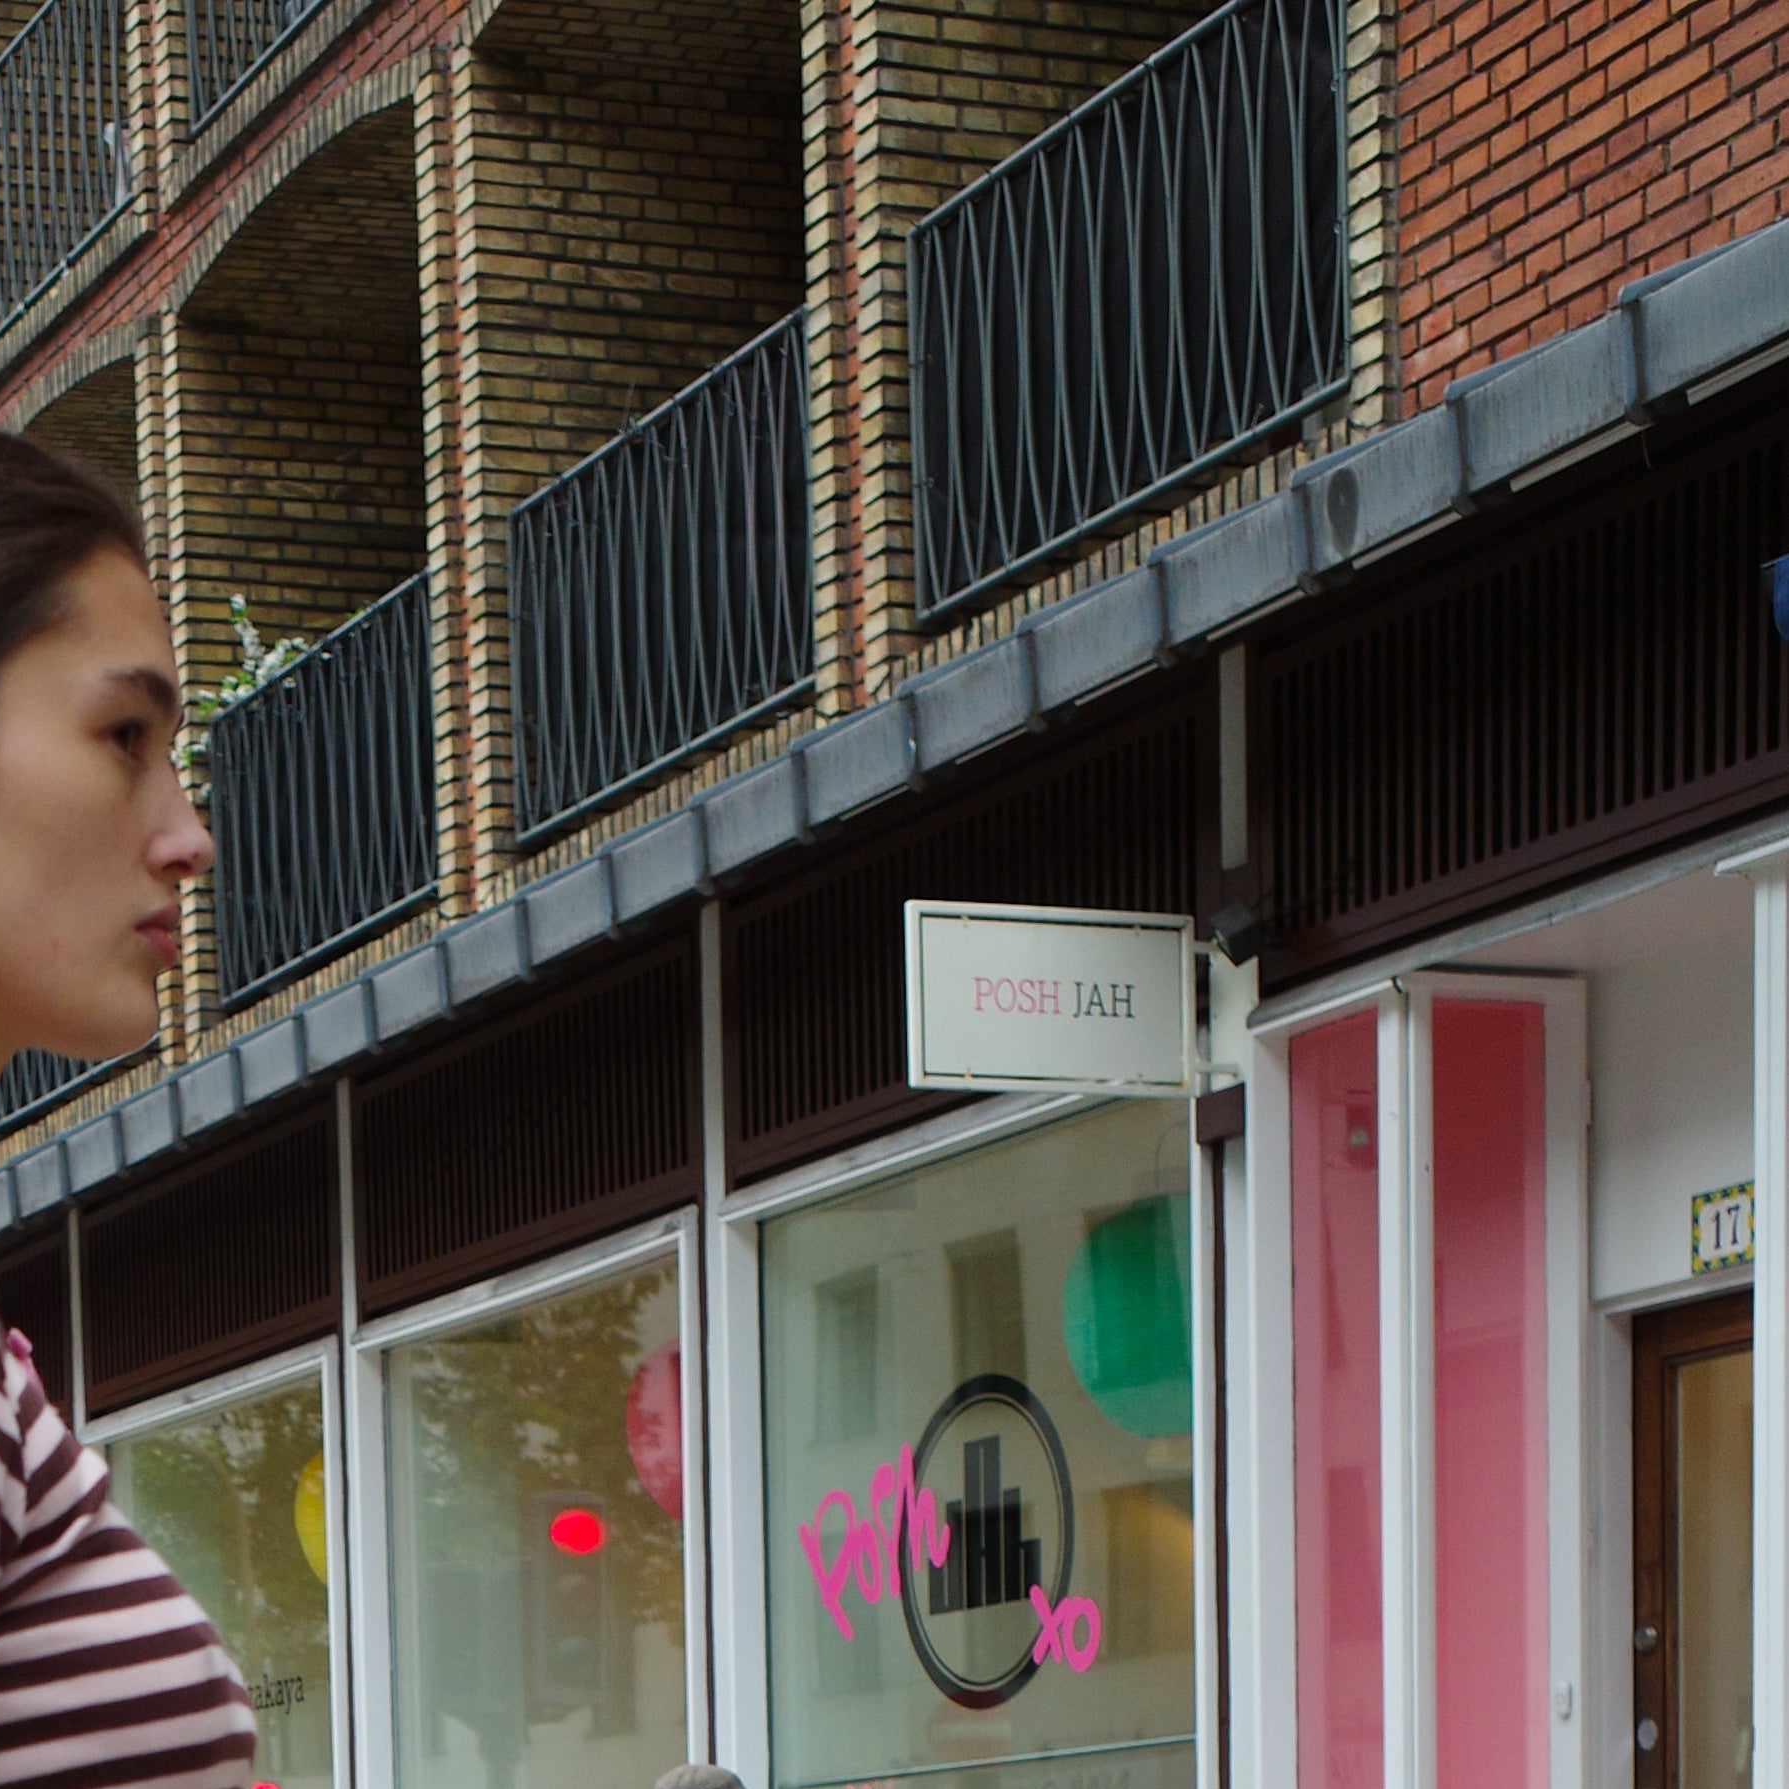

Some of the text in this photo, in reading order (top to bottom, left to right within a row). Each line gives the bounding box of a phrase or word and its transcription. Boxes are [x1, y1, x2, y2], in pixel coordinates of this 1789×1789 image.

[973, 976, 1135, 1019] POSH JAH
[1712, 1203, 1741, 1251] 17
